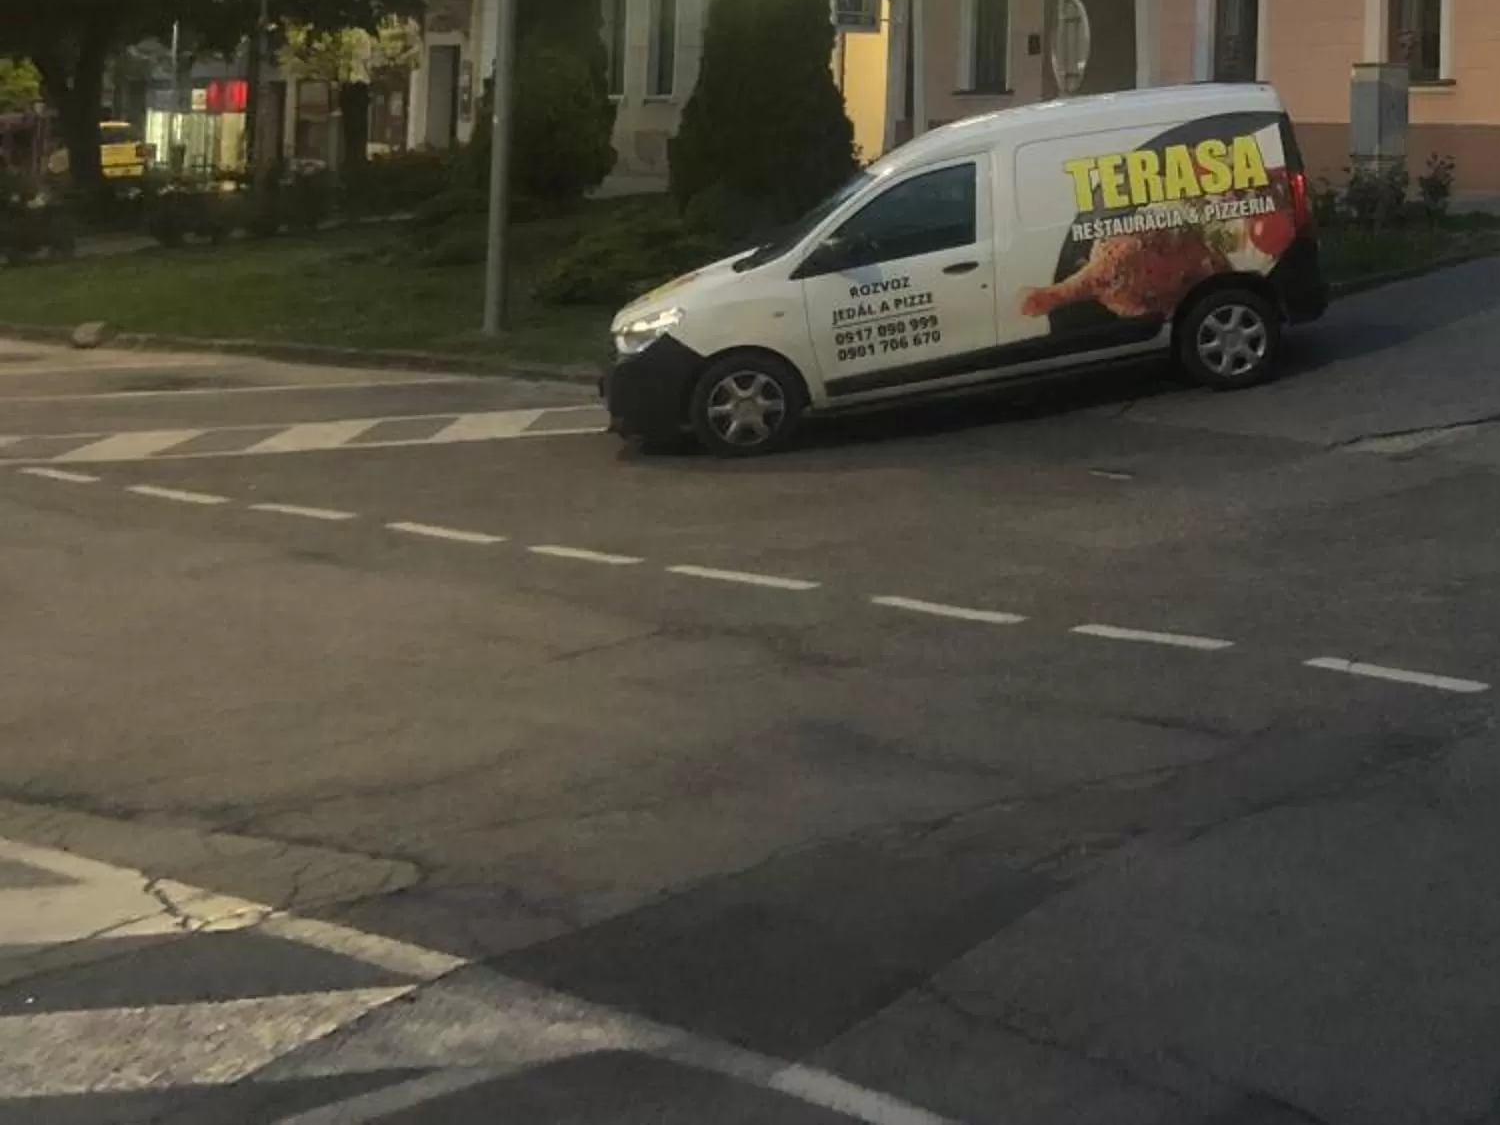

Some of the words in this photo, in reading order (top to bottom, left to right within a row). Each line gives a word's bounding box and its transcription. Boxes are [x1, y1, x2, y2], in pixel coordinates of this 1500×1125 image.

[1064, 133, 1270, 213] TERASA
[1204, 196, 1276, 222] PIZZERIA
[849, 276, 912, 299] ROZVOZ
[880, 301, 890, 313] A
[835, 326, 873, 345] 0917
